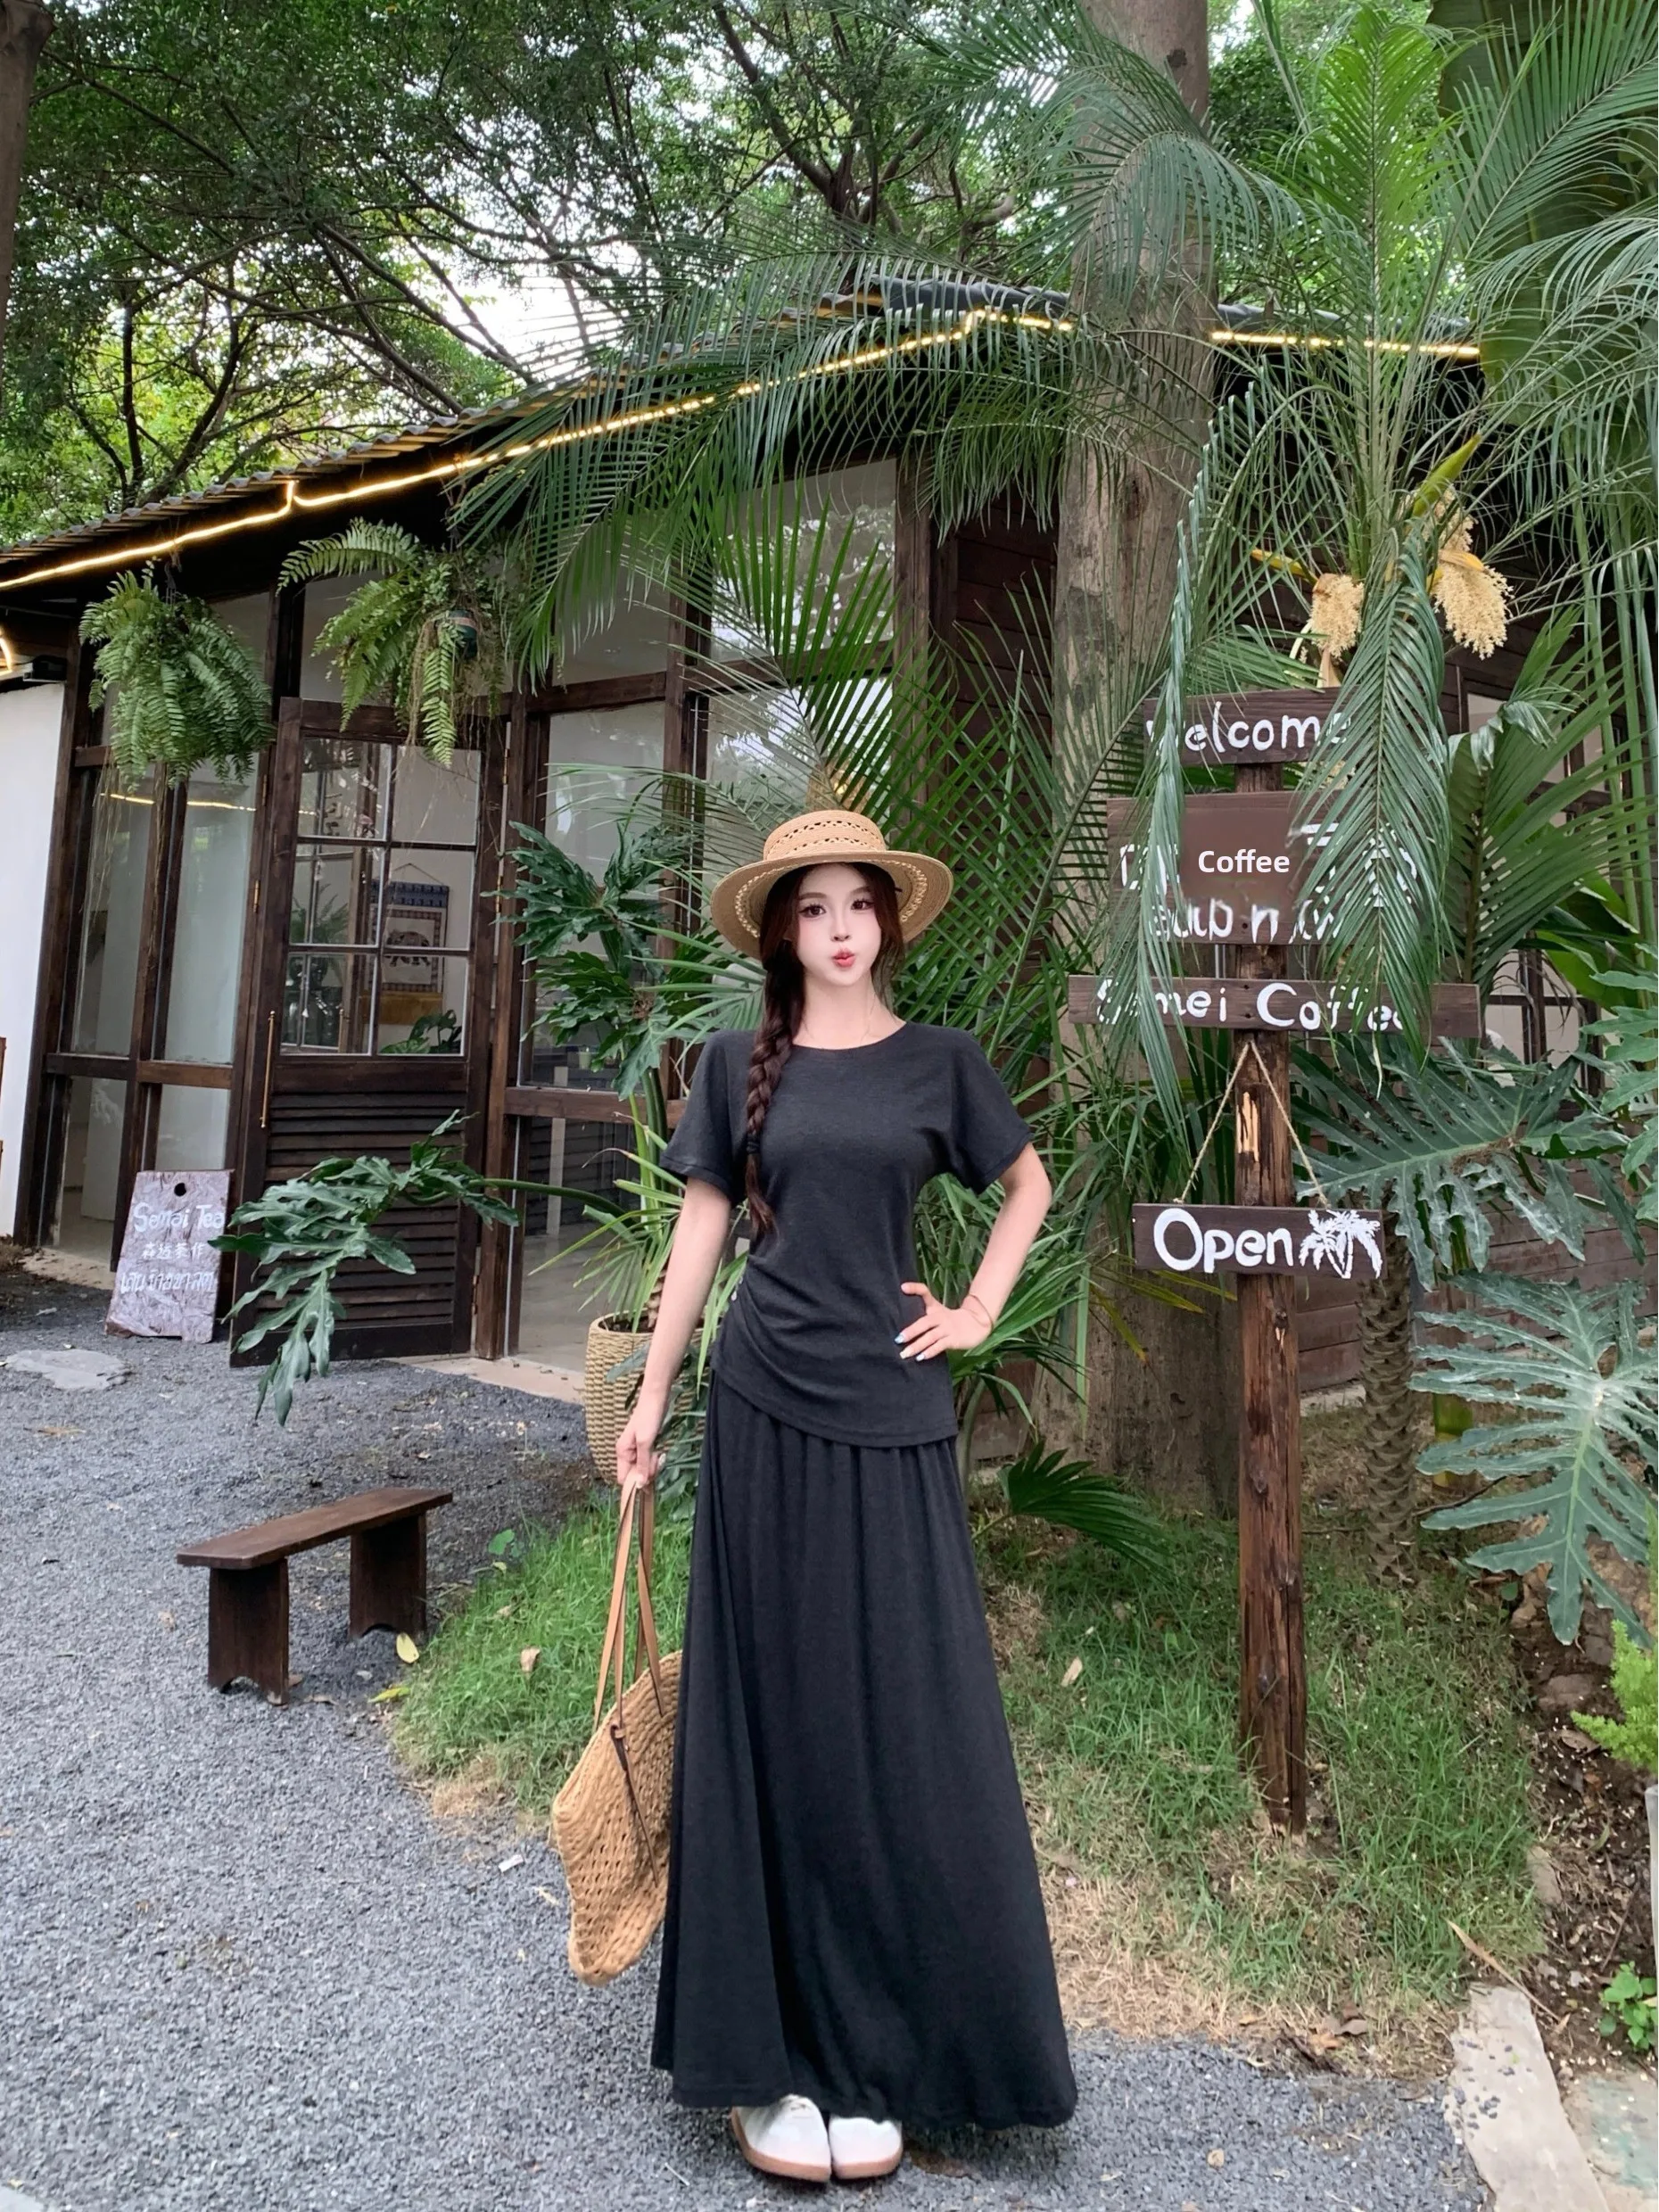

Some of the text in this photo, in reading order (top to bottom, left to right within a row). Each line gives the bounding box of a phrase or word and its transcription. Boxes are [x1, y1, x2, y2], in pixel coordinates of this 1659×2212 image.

[1145, 701, 1351, 757] elcome
[1096, 978, 1227, 1025] mei
[195, 1204, 225, 1231] Tea
[1153, 1208, 1293, 1274] Open
